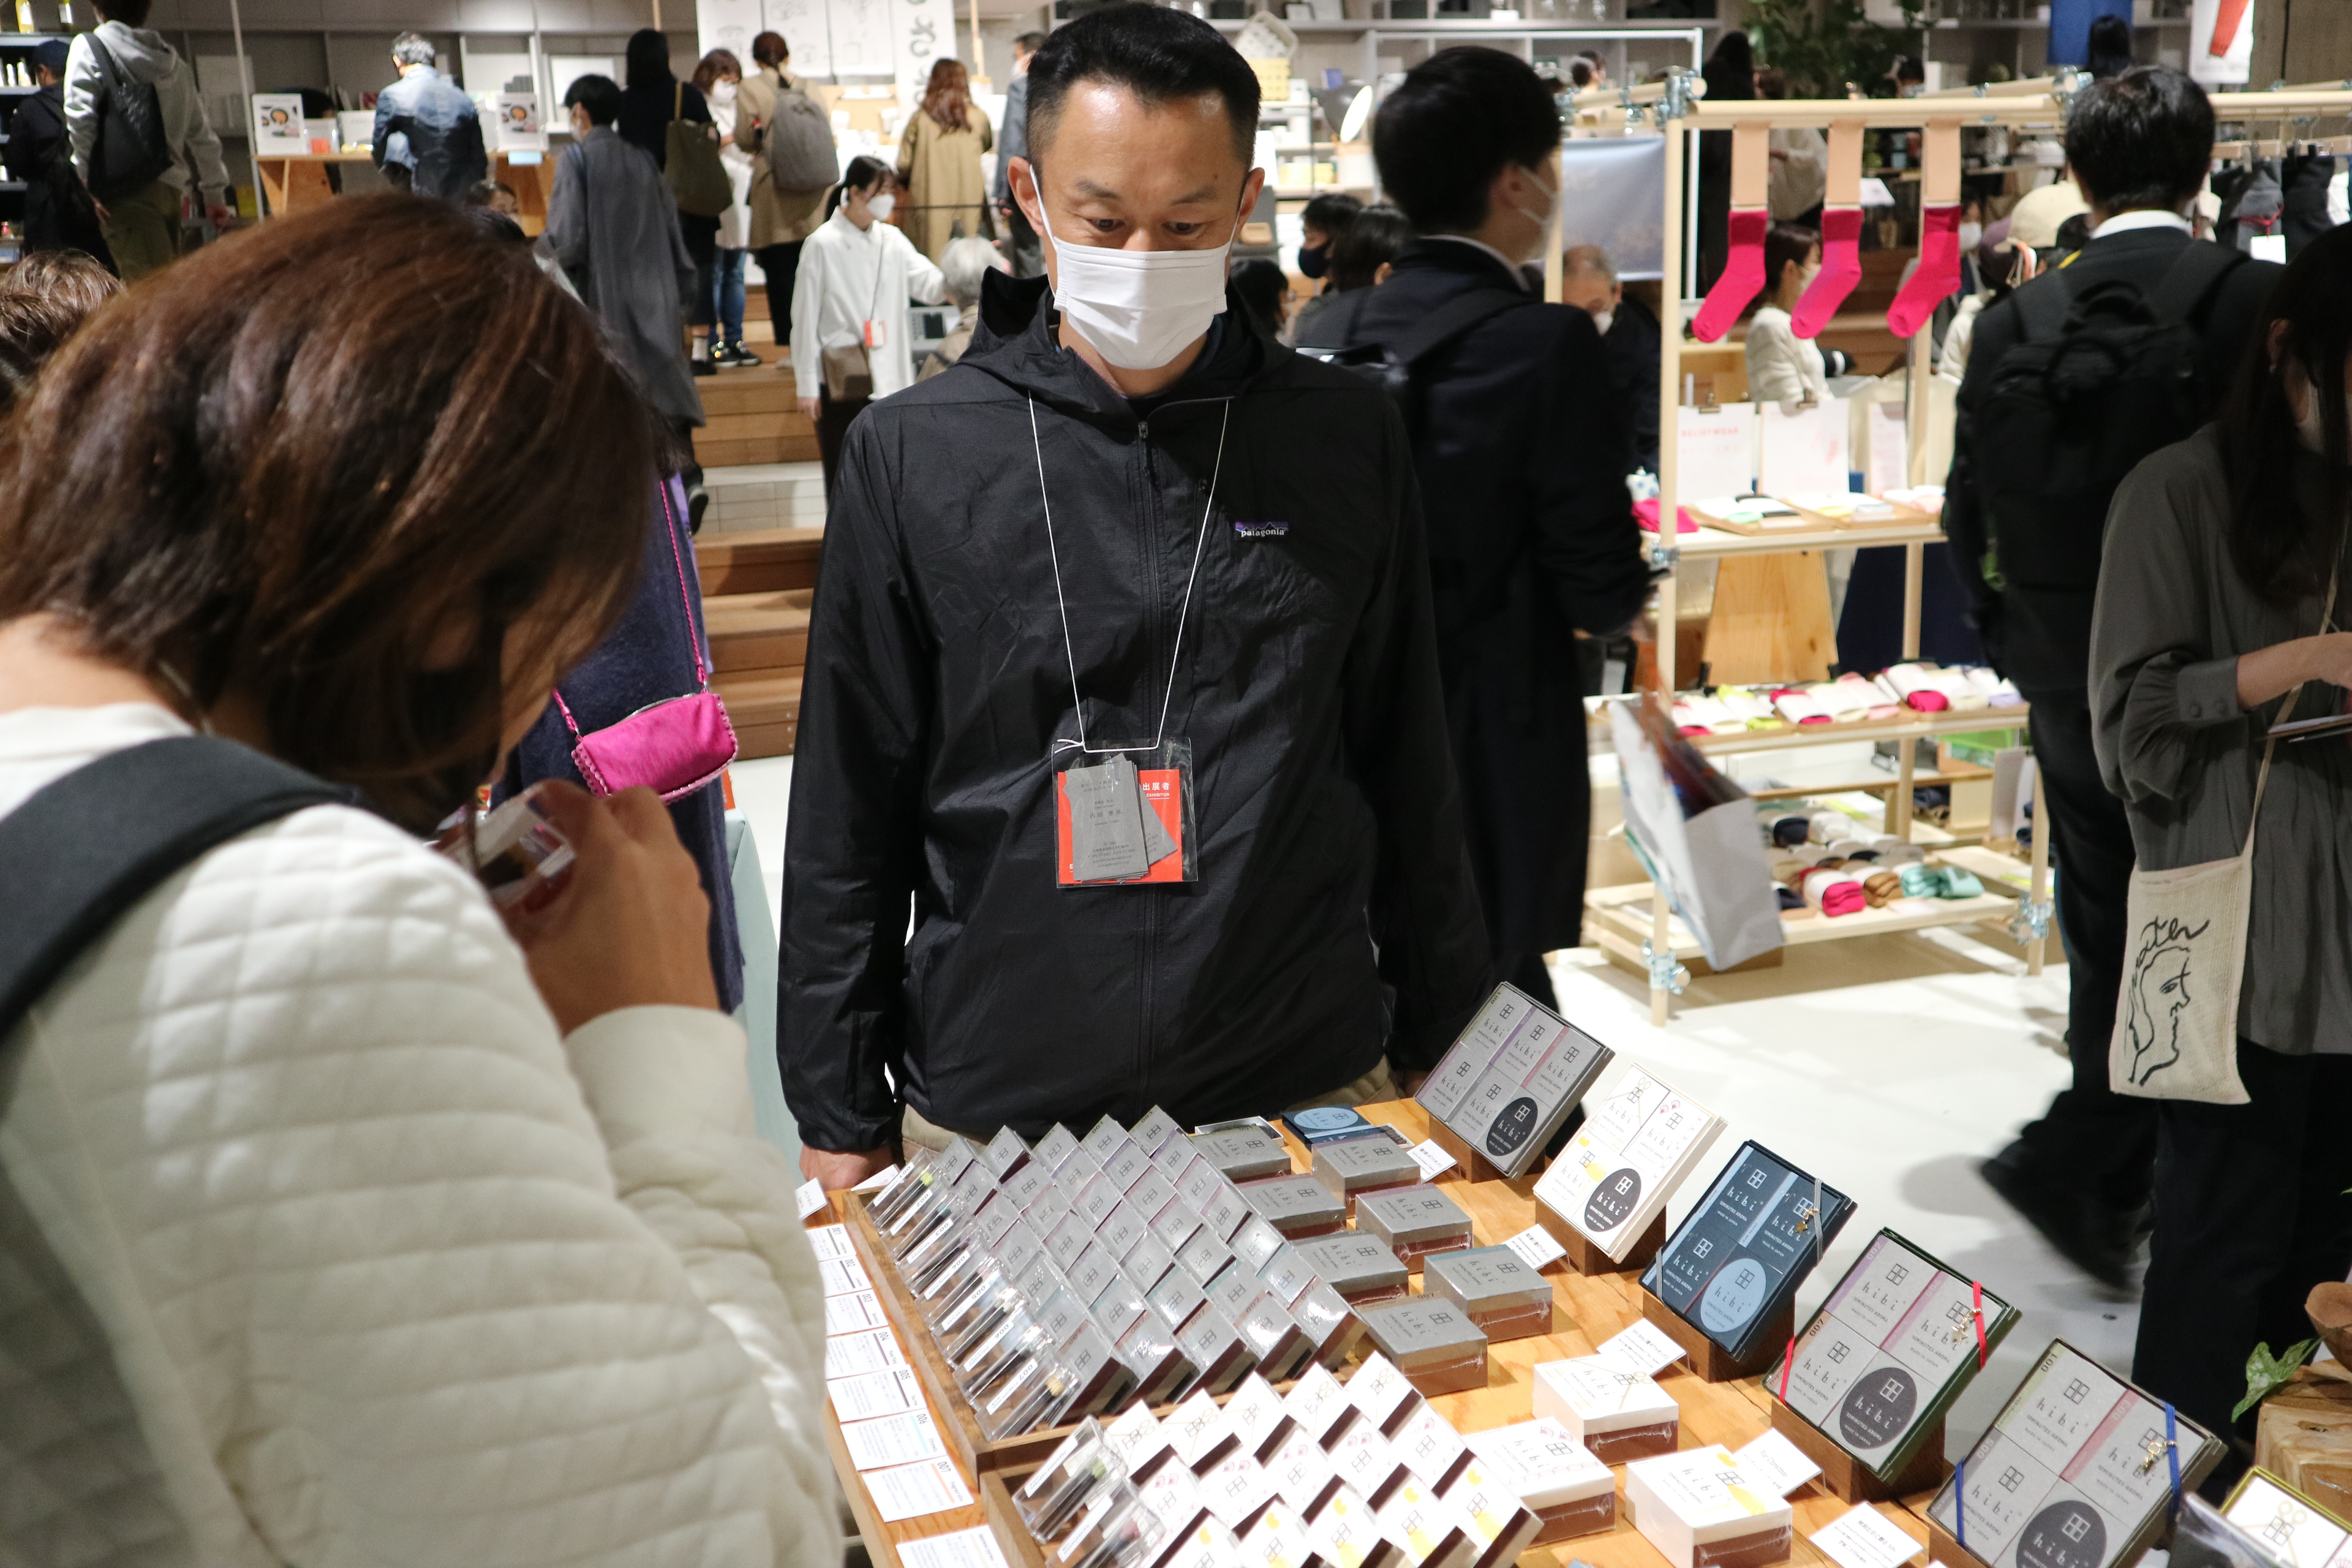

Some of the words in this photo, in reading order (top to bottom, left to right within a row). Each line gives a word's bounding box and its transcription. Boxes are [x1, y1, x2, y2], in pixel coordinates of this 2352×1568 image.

[1241, 529, 1284, 537] patagonia
[1491, 992, 1501, 1004] 001
[1484, 1019, 1503, 1037] hibi
[1514, 1039, 1536, 1059] hibi
[1547, 1061, 1571, 1082] hibi
[1441, 1076, 1463, 1095] hibi
[1471, 1098, 1493, 1118] hibi
[1610, 1102, 1635, 1123] hibi
[1498, 1120, 1521, 1140] hibi
[1647, 1129, 1673, 1150] hibi
[1350, 1146, 1373, 1163] hibi
[899, 1166, 911, 1178] 001
[917, 1194, 929, 1207] 002
[1396, 1199, 1421, 1217] hibi
[1597, 1192, 1623, 1216] hibi
[1727, 1186, 1757, 1211] hibi
[1589, 1205, 1604, 1218] 10MINUTES
[1603, 1216, 1613, 1225] AROMA
[1719, 1200, 1736, 1213] 10MINUTES
[1735, 1212, 1747, 1221] AROMA
[936, 1223, 949, 1235] 003
[1772, 1216, 1801, 1241] hibi
[1763, 1230, 1782, 1244] 10MINUTES
[1781, 1242, 1794, 1253] AROMA
[952, 1256, 965, 1270] 004
[1331, 1245, 1355, 1265] hibi
[1470, 1261, 1498, 1282] hibi
[1673, 1255, 1703, 1281] hibi
[1665, 1268, 1682, 1283] 10MINUTES
[1681, 1281, 1692, 1291] AROMA
[862, 1294, 873, 1303] 003
[972, 1286, 985, 1299] 005
[1714, 1287, 1744, 1313] hibi
[1863, 1282, 1899, 1311] hibi
[1706, 1300, 1724, 1315] 10MINUTES
[1722, 1313, 1735, 1324] AROMA
[1853, 1296, 1874, 1313] 10MINUTES
[1873, 1311, 1888, 1322] AROMA
[995, 1324, 1009, 1338] 006
[1401, 1311, 1430, 1334] hibi
[1809, 1319, 1824, 1336] 007
[879, 1332, 890, 1341] 004
[1921, 1319, 1958, 1351] hibi
[1912, 1335, 1934, 1352] 10MINUTES
[1934, 1351, 1950, 1363] AROMA
[1019, 1365, 1033, 1381] 007
[2041, 1353, 2057, 1373] 001
[899, 1370, 911, 1379] 005
[1583, 1370, 1615, 1396] hibi
[1804, 1359, 1839, 1389] hibi
[1794, 1373, 1815, 1390] 10MINUTES
[1814, 1389, 1828, 1401] AROMA
[916, 1414, 929, 1425] 006
[1855, 1397, 1893, 1429] hibi
[2037, 1398, 2079, 1434] hibi
[1845, 1412, 1868, 1430] 10MINUTES
[1867, 1428, 1882, 1441] AROMA
[2026, 1414, 2051, 1434] 10MINUTES
[2050, 1433, 2068, 1447] AROMA
[1513, 1440, 1548, 1468] hibi
[1977, 1439, 1994, 1459] 005
[937, 1461, 951, 1473] 007
[1682, 1469, 1721, 1499] hibi
[2097, 1464, 2125, 1487] 10MINUTES
[2124, 1485, 2143, 1500] AROMA
[1972, 1485, 2013, 1523] hibi
[1963, 1502, 1985, 1523] 0MINUTES
[1986, 1522, 2002, 1536] AROMA
